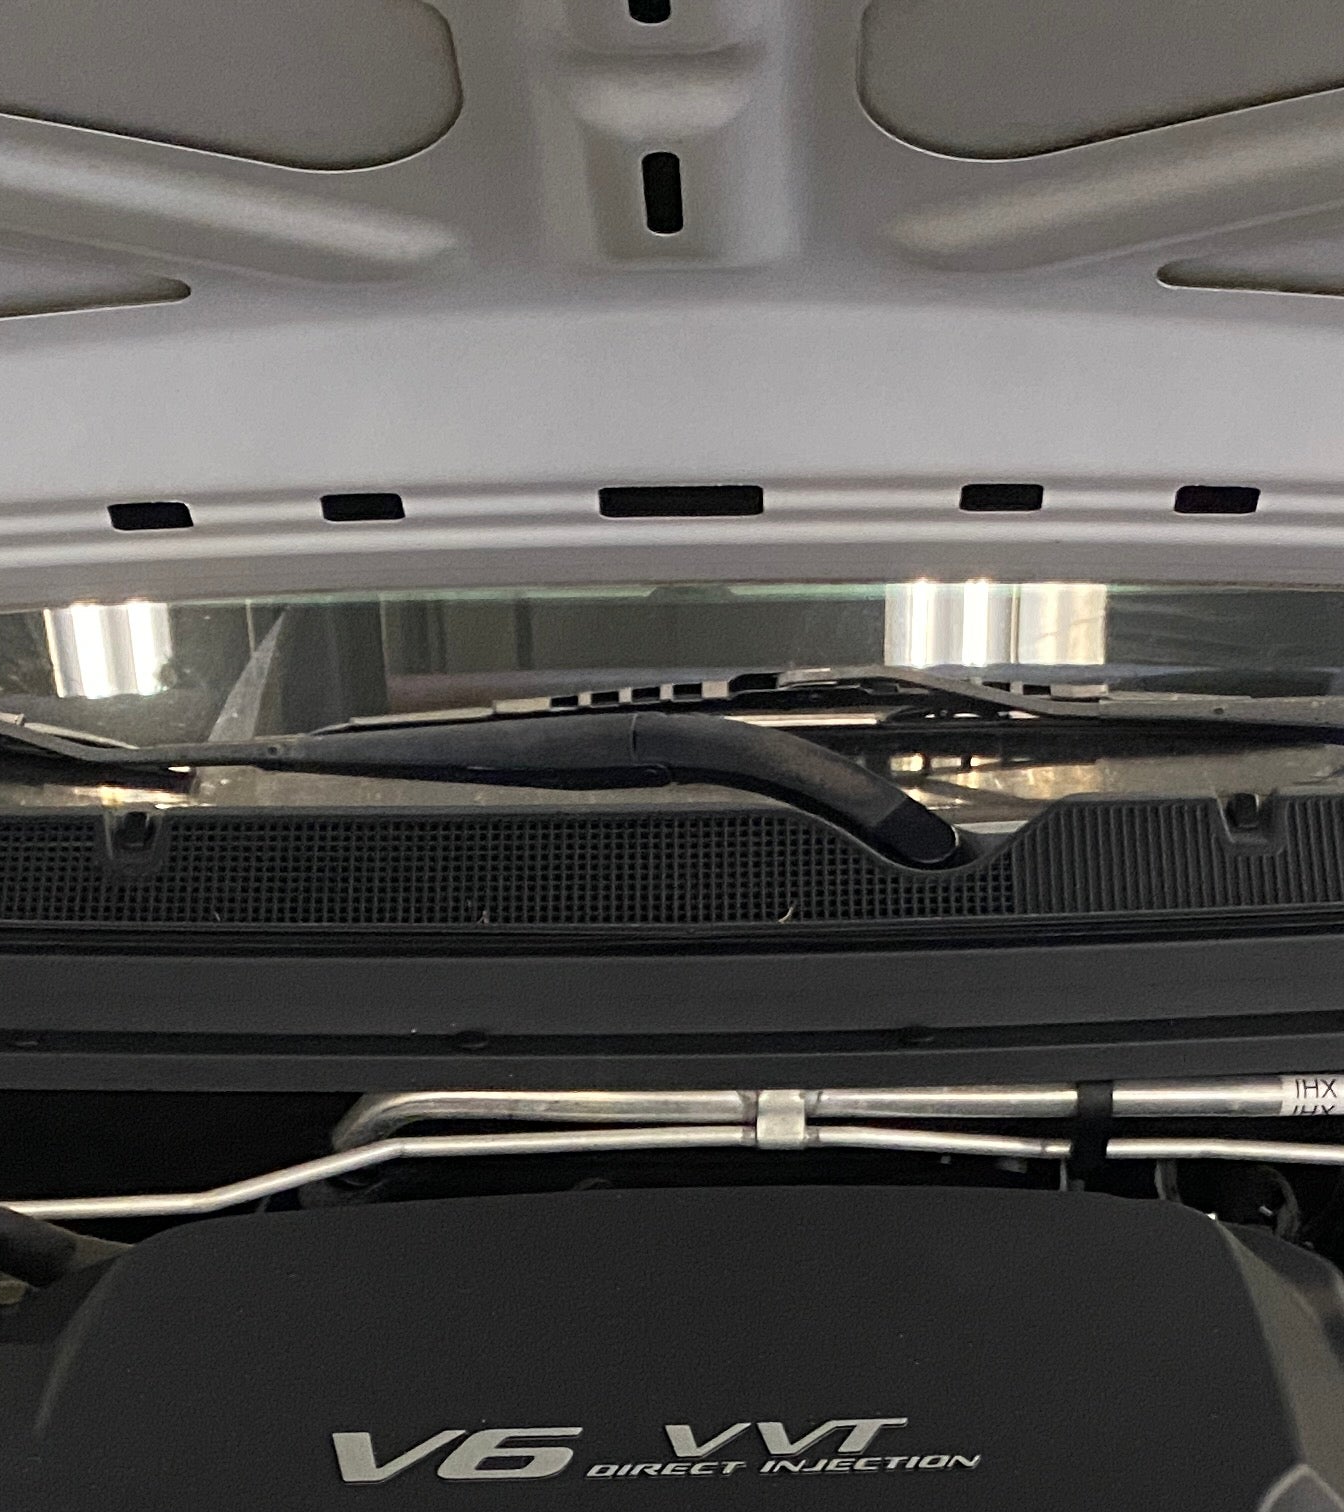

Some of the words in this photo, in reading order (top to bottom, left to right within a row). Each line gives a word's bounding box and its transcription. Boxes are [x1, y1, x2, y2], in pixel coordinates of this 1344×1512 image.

[1295, 1079, 1337, 1098] IHX
[332, 1427, 583, 1482] V6
[664, 1417, 908, 1458] VVT
[586, 1461, 746, 1478] DIRECT
[759, 1454, 981, 1474] INJECTION
